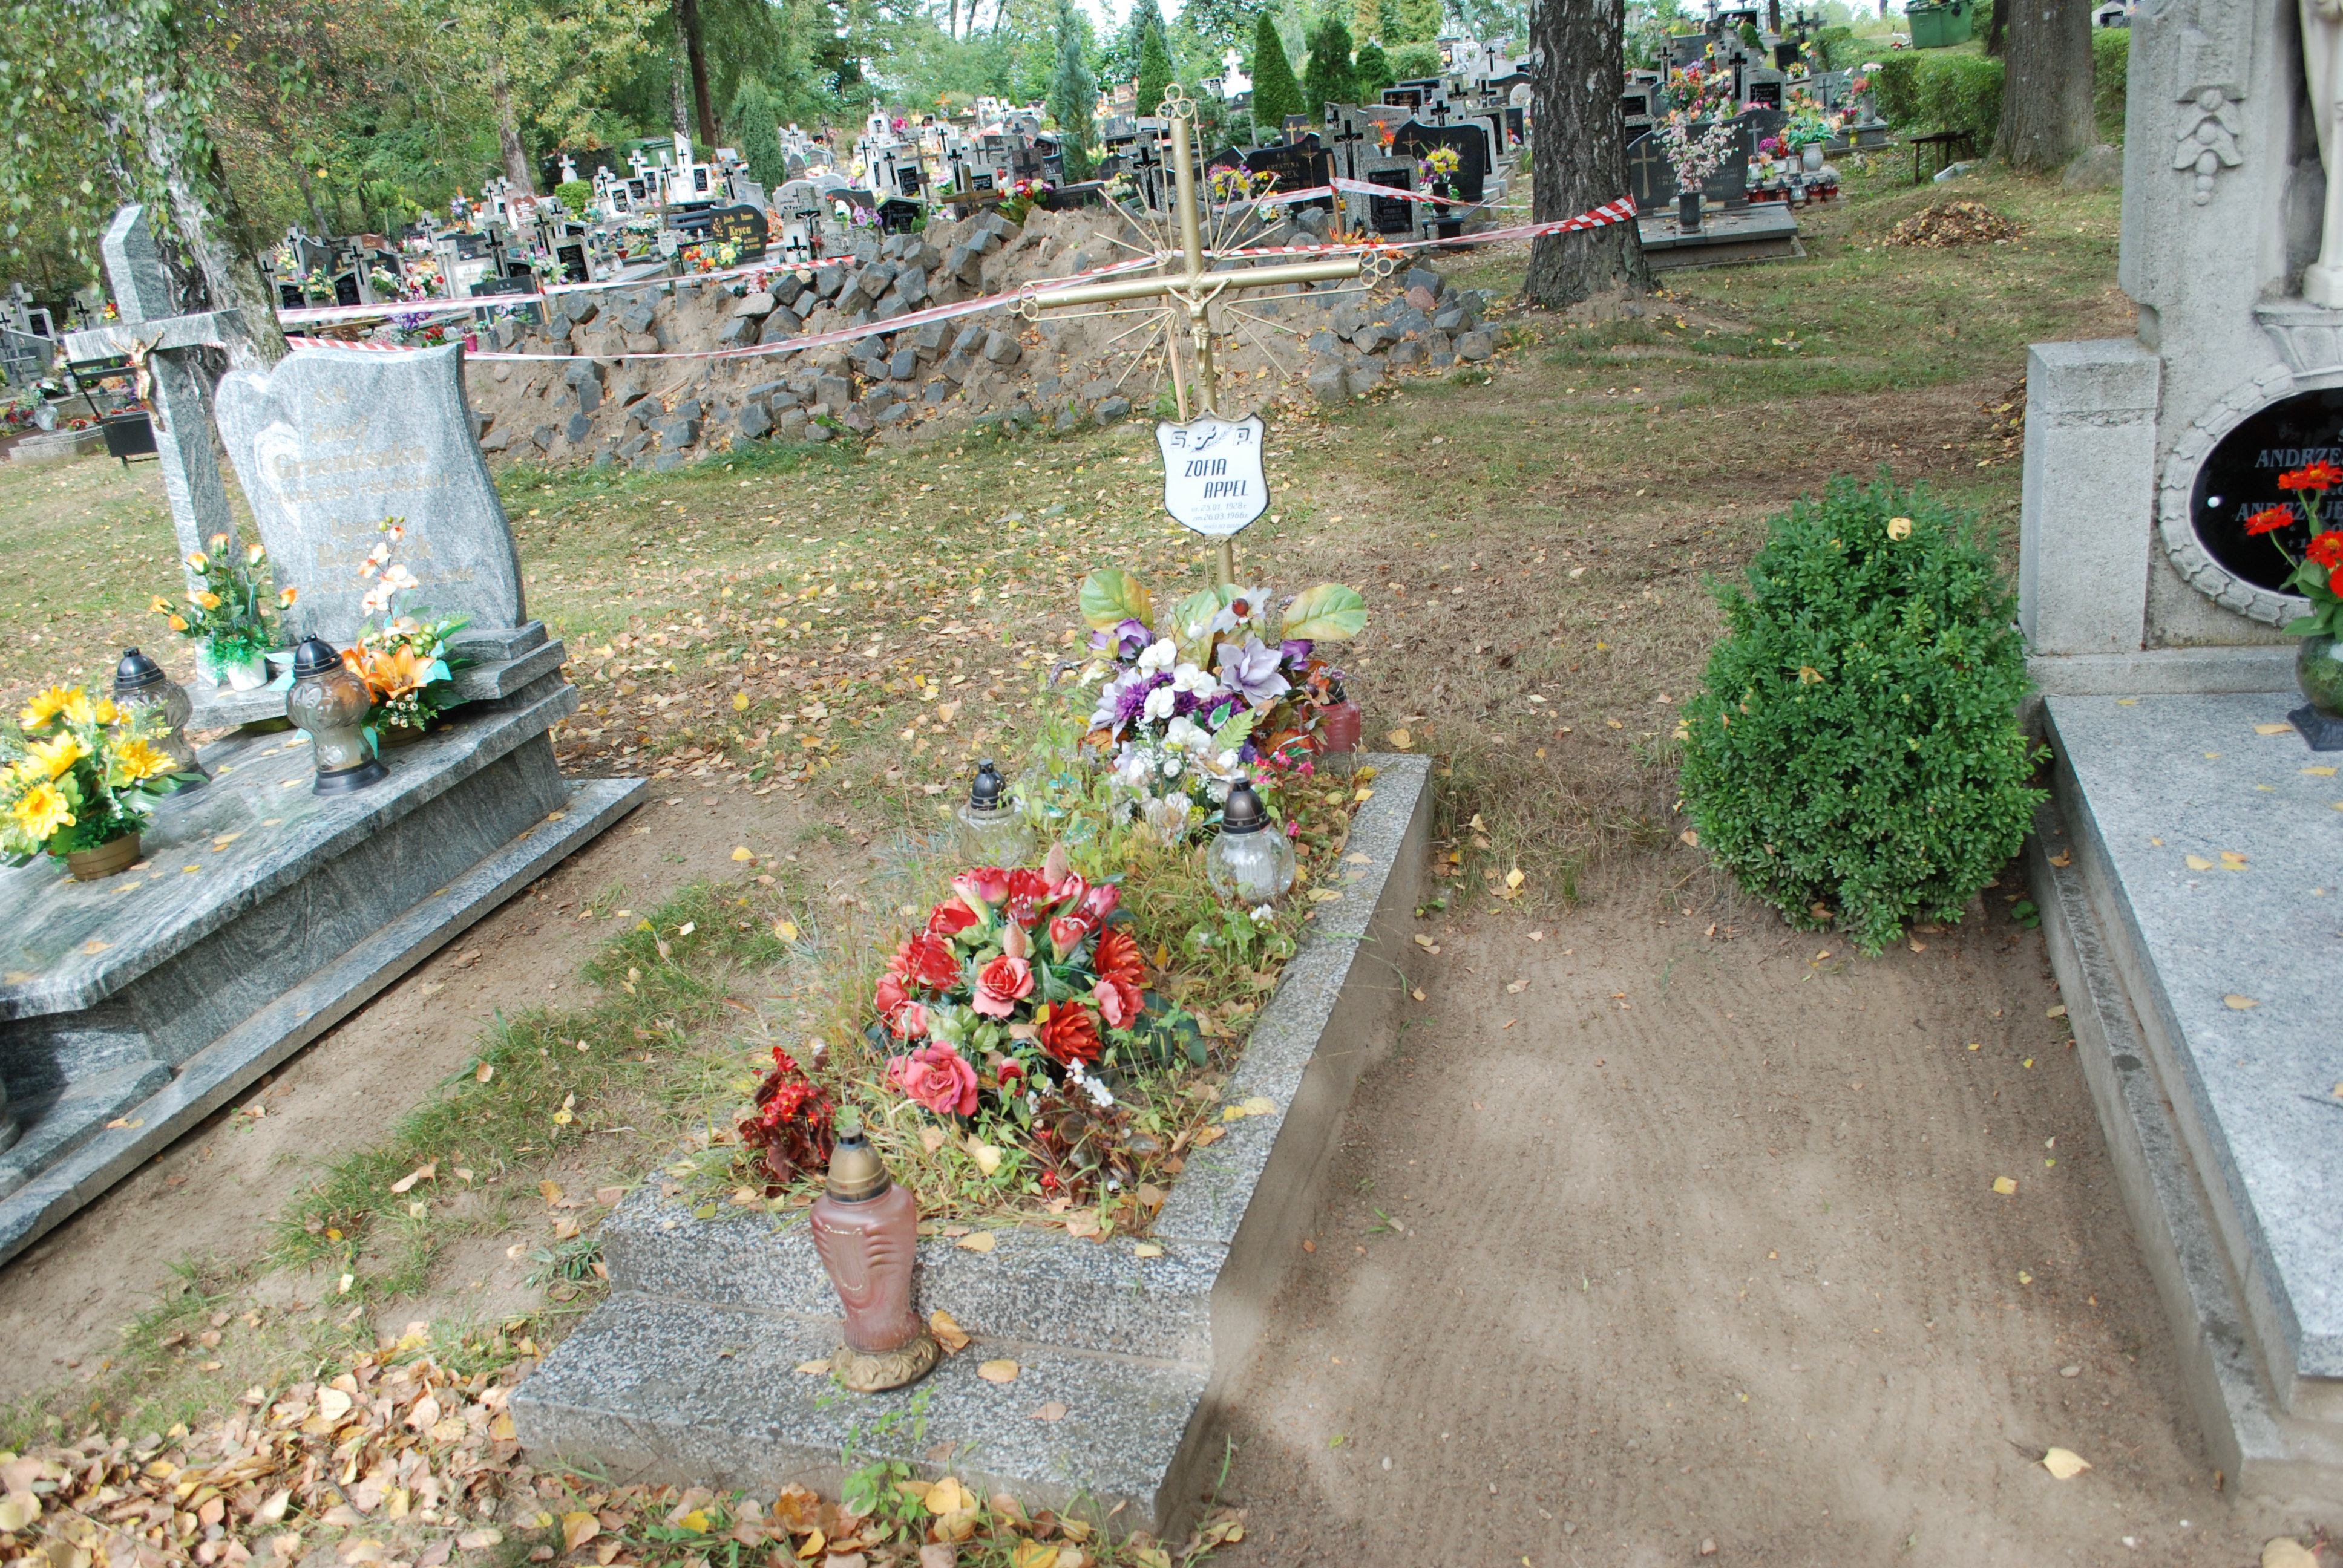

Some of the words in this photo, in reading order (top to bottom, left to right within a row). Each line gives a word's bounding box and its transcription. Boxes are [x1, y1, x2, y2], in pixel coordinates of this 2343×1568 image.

[2254, 448, 2343, 468] ANDRZE
[1184, 459, 1227, 477] ZOFIA
[1204, 480, 1248, 499] APPEL
